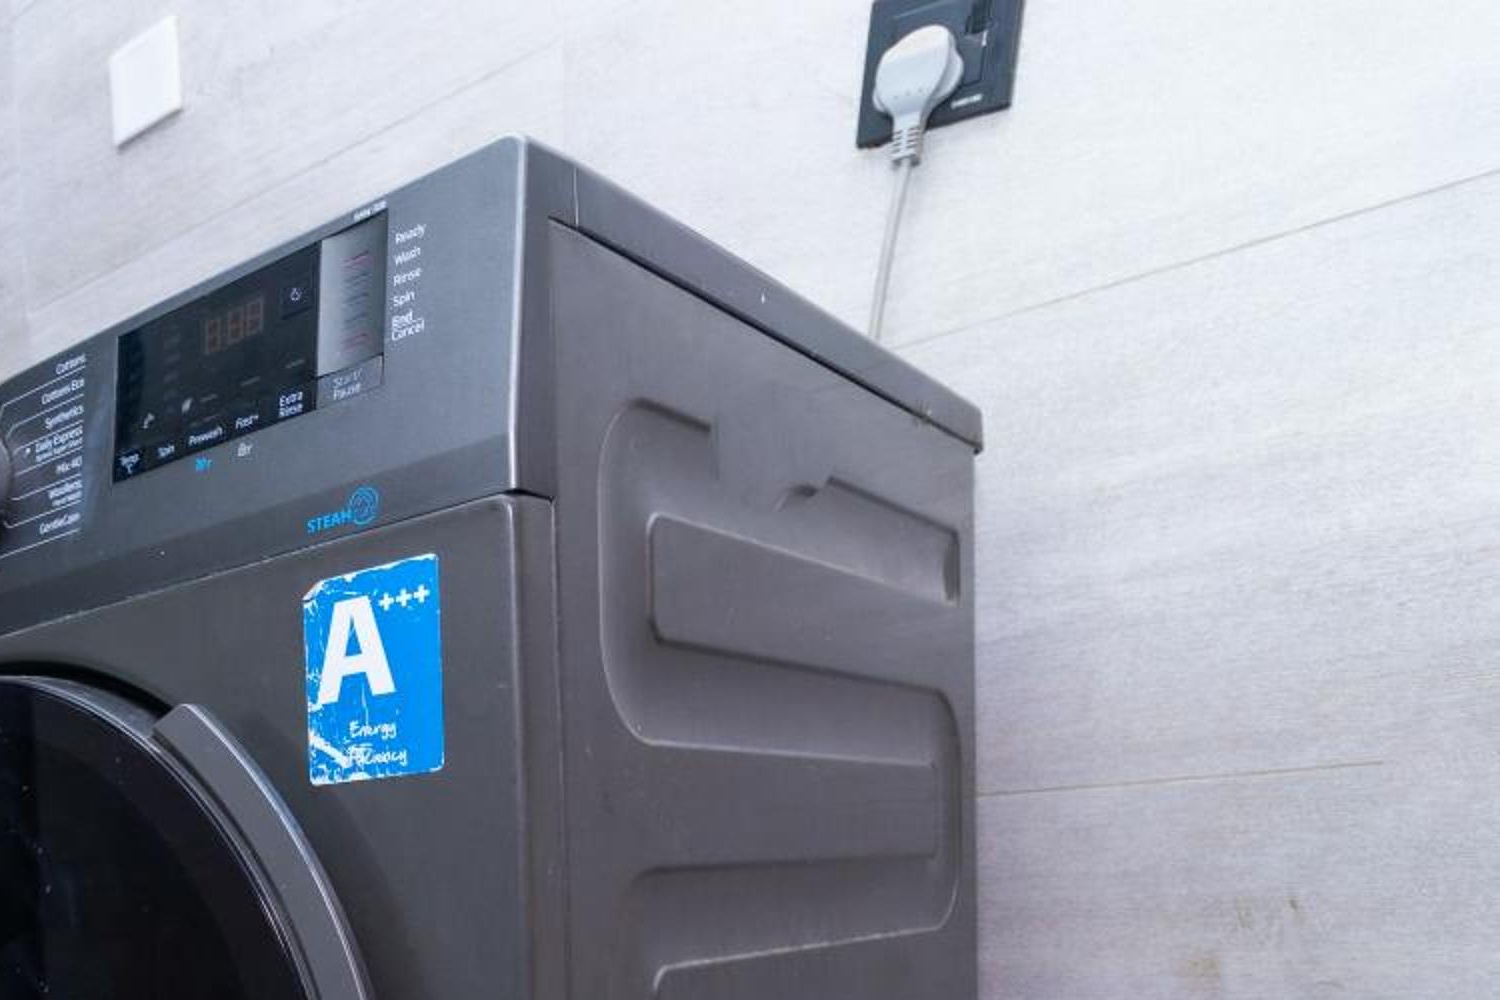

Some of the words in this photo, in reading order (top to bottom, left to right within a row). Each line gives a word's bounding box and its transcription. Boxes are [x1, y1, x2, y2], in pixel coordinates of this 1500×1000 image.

[395, 224, 427, 244] Ready
[395, 247, 421, 266] Wash
[393, 268, 421, 286] Rinse
[392, 291, 416, 307] Spin
[391, 319, 425, 341] Cancel
[279, 391, 304, 407] Extra
[45, 405, 84, 431] Synthetics
[307, 508, 355, 534] STEAM
[349, 720, 398, 741] Energy
